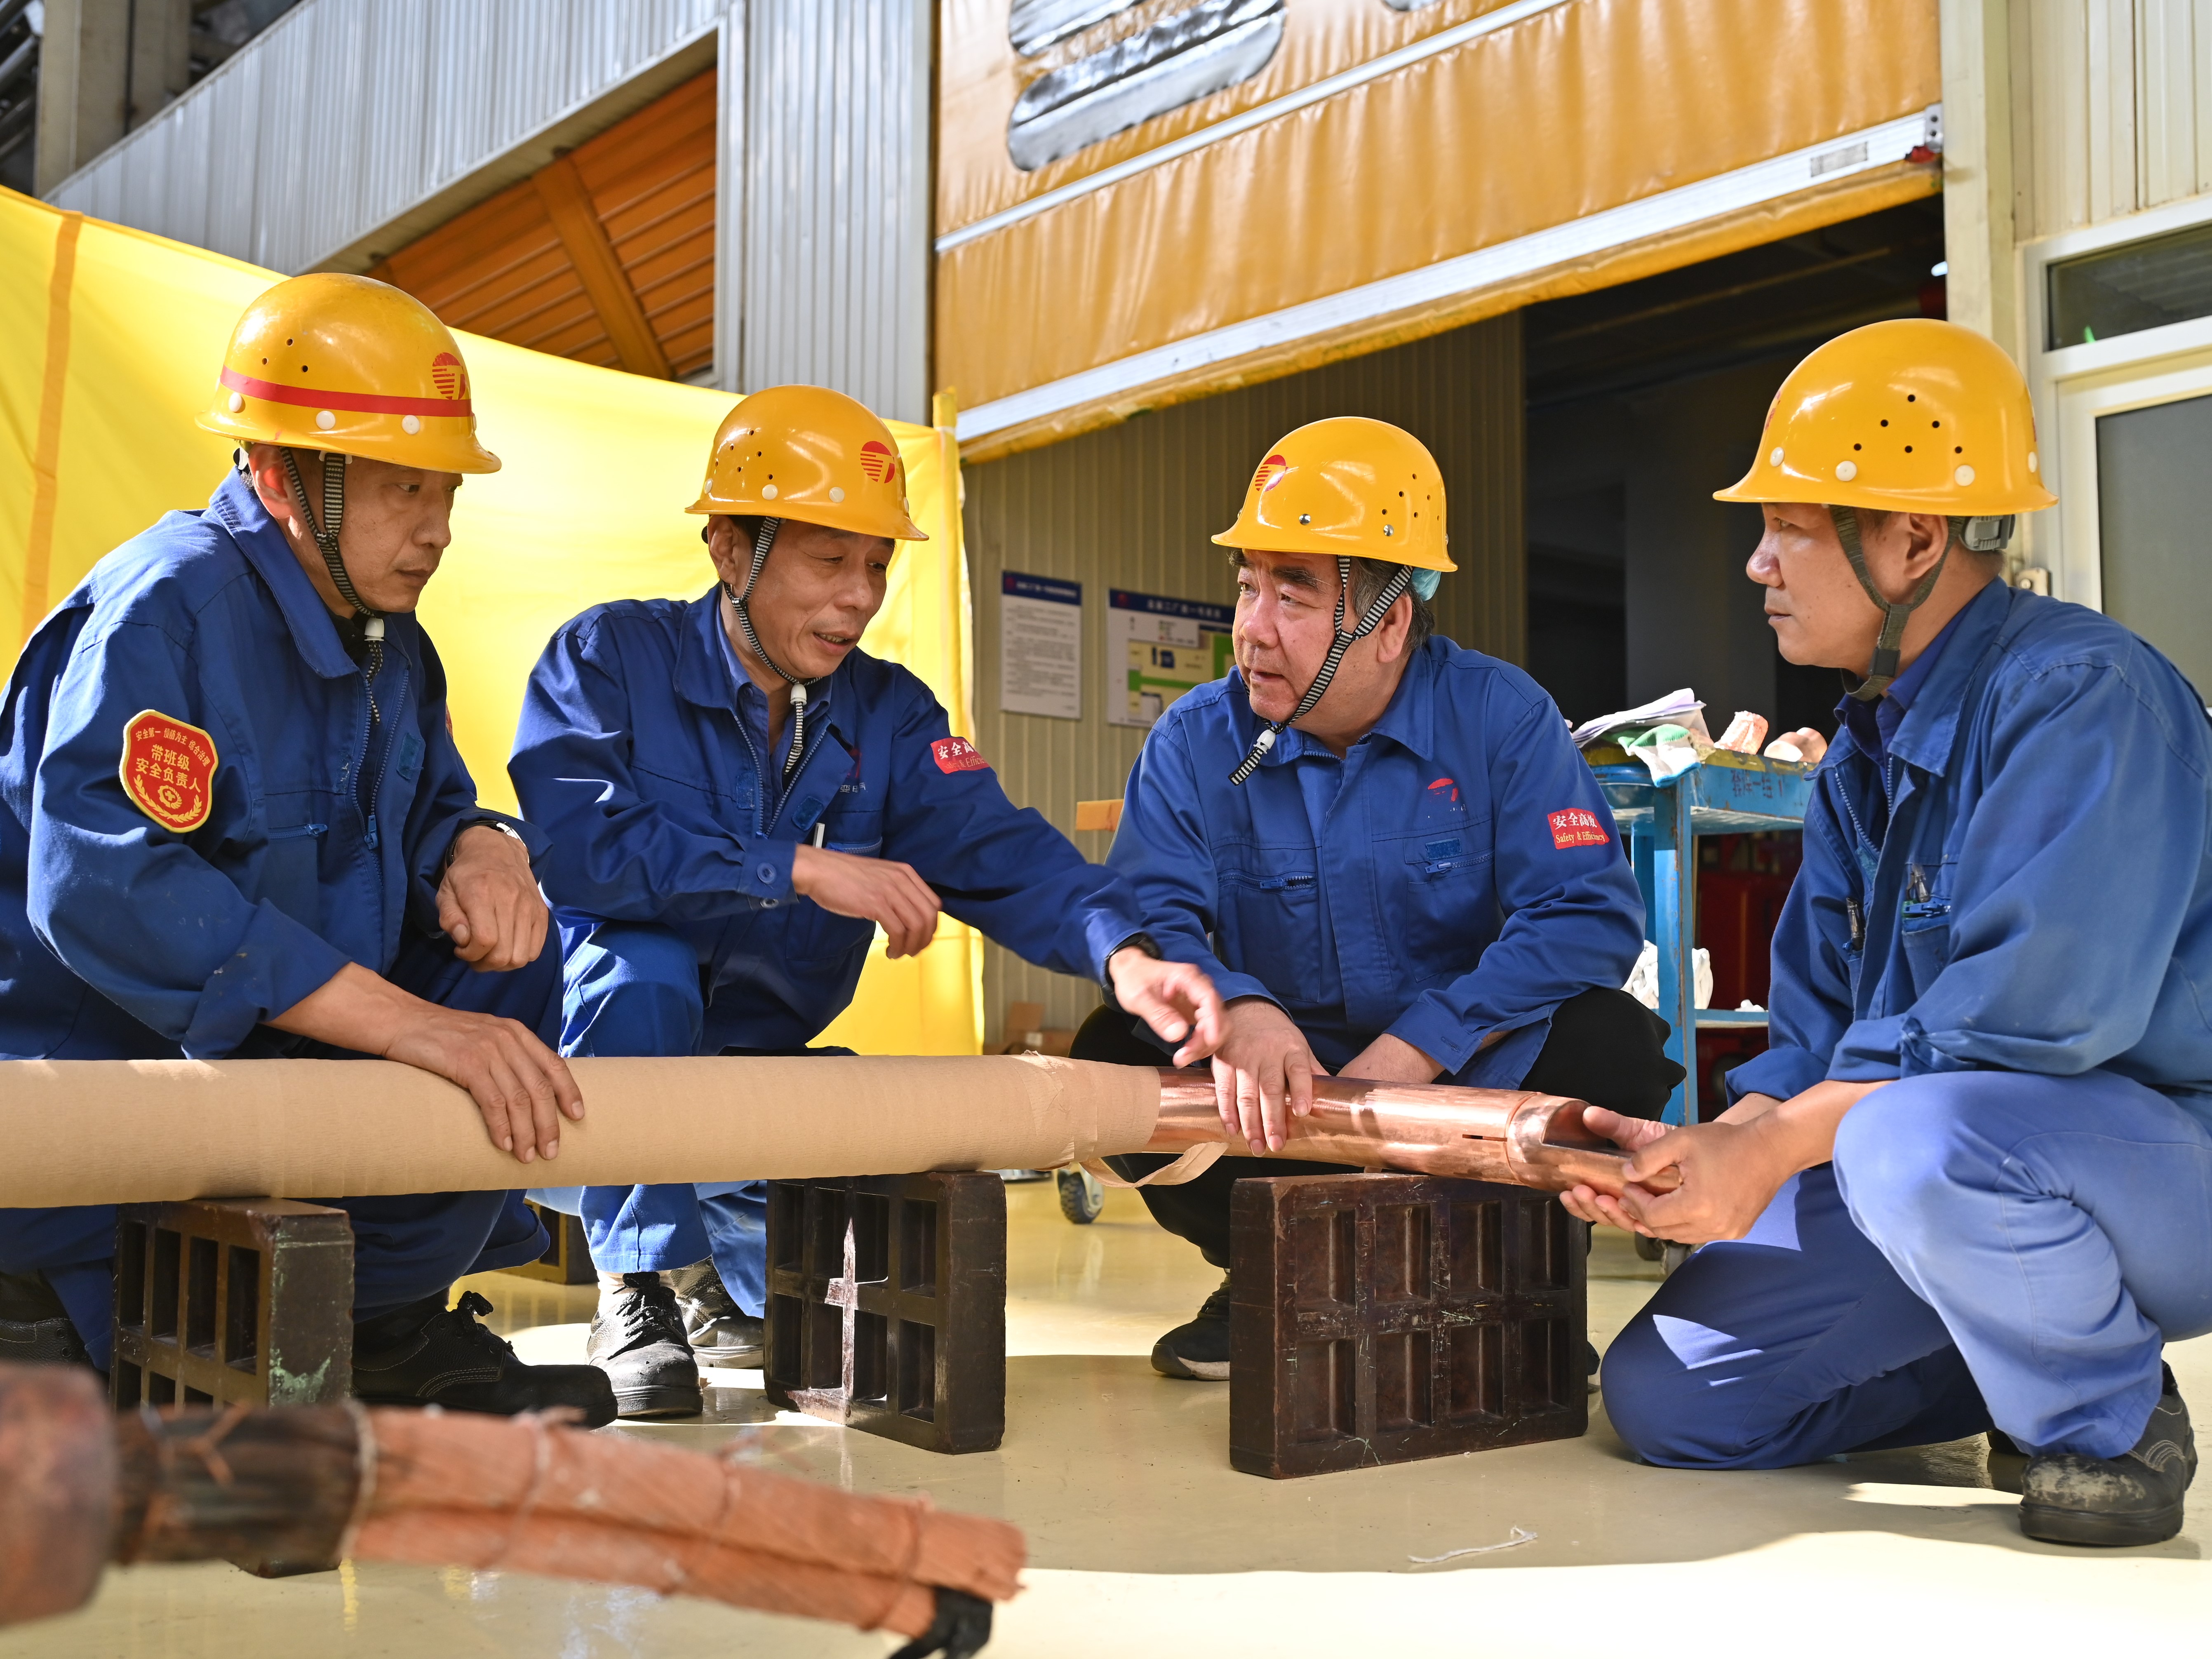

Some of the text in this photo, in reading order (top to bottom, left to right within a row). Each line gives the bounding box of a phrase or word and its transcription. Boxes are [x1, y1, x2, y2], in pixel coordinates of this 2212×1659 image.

[136, 727, 211, 767] 安全第一 预防为主 综合治理
[151, 744, 190, 771] 带班级
[959, 759, 966, 768] &
[135, 757, 202, 793] 安全负责人
[1553, 812, 1598, 830] 安全高效
[1556, 831, 1606, 844] Safety & Efficiency
